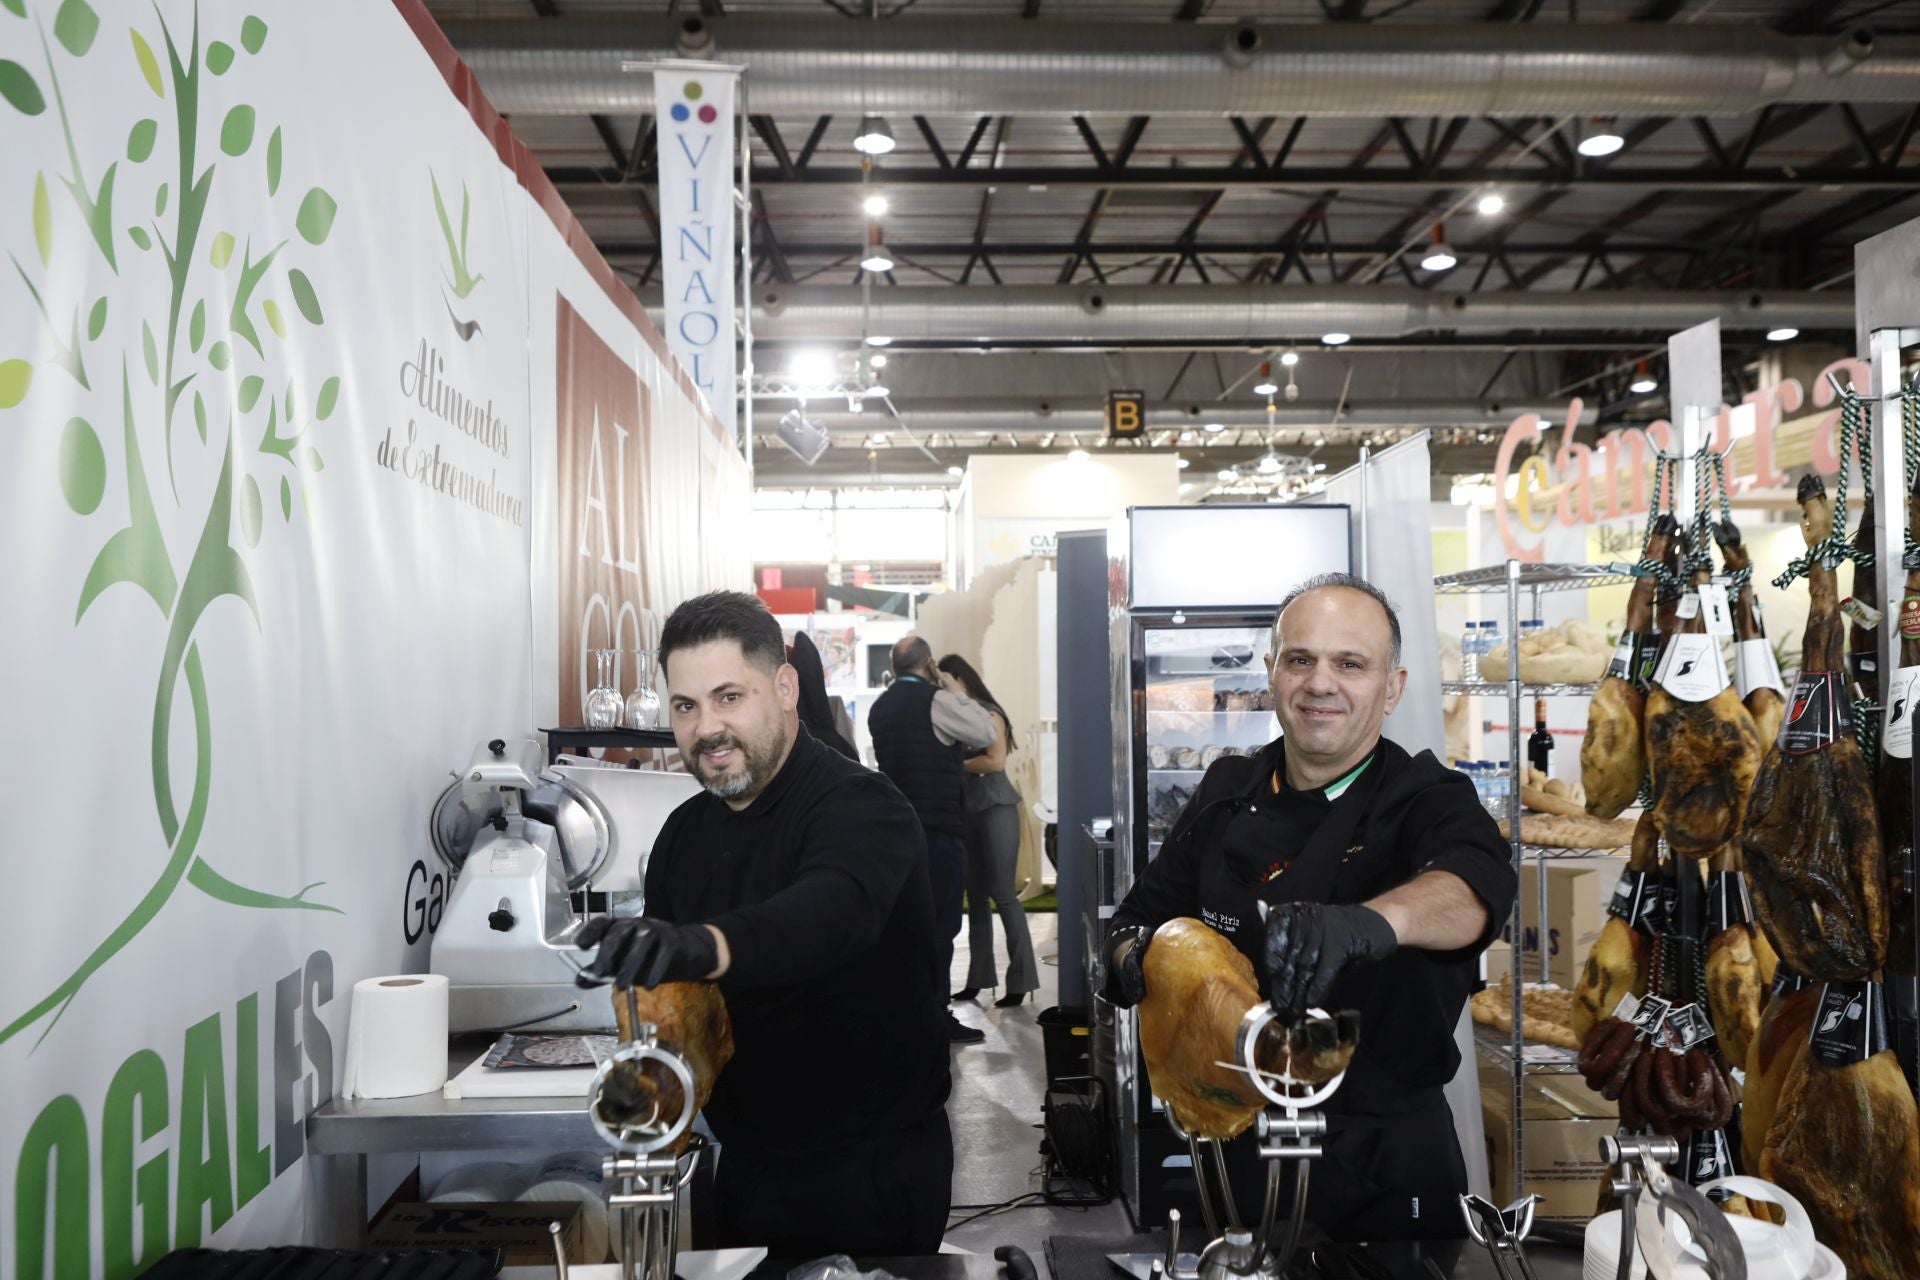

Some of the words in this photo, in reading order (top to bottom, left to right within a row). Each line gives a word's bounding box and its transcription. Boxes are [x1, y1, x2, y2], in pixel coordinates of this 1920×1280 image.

[400, 337, 509, 459] Alimentos
[1116, 400, 1139, 431] B
[377, 426, 399, 473] de
[402, 418, 525, 528] Extremadura
[580, 402, 638, 574] AL
